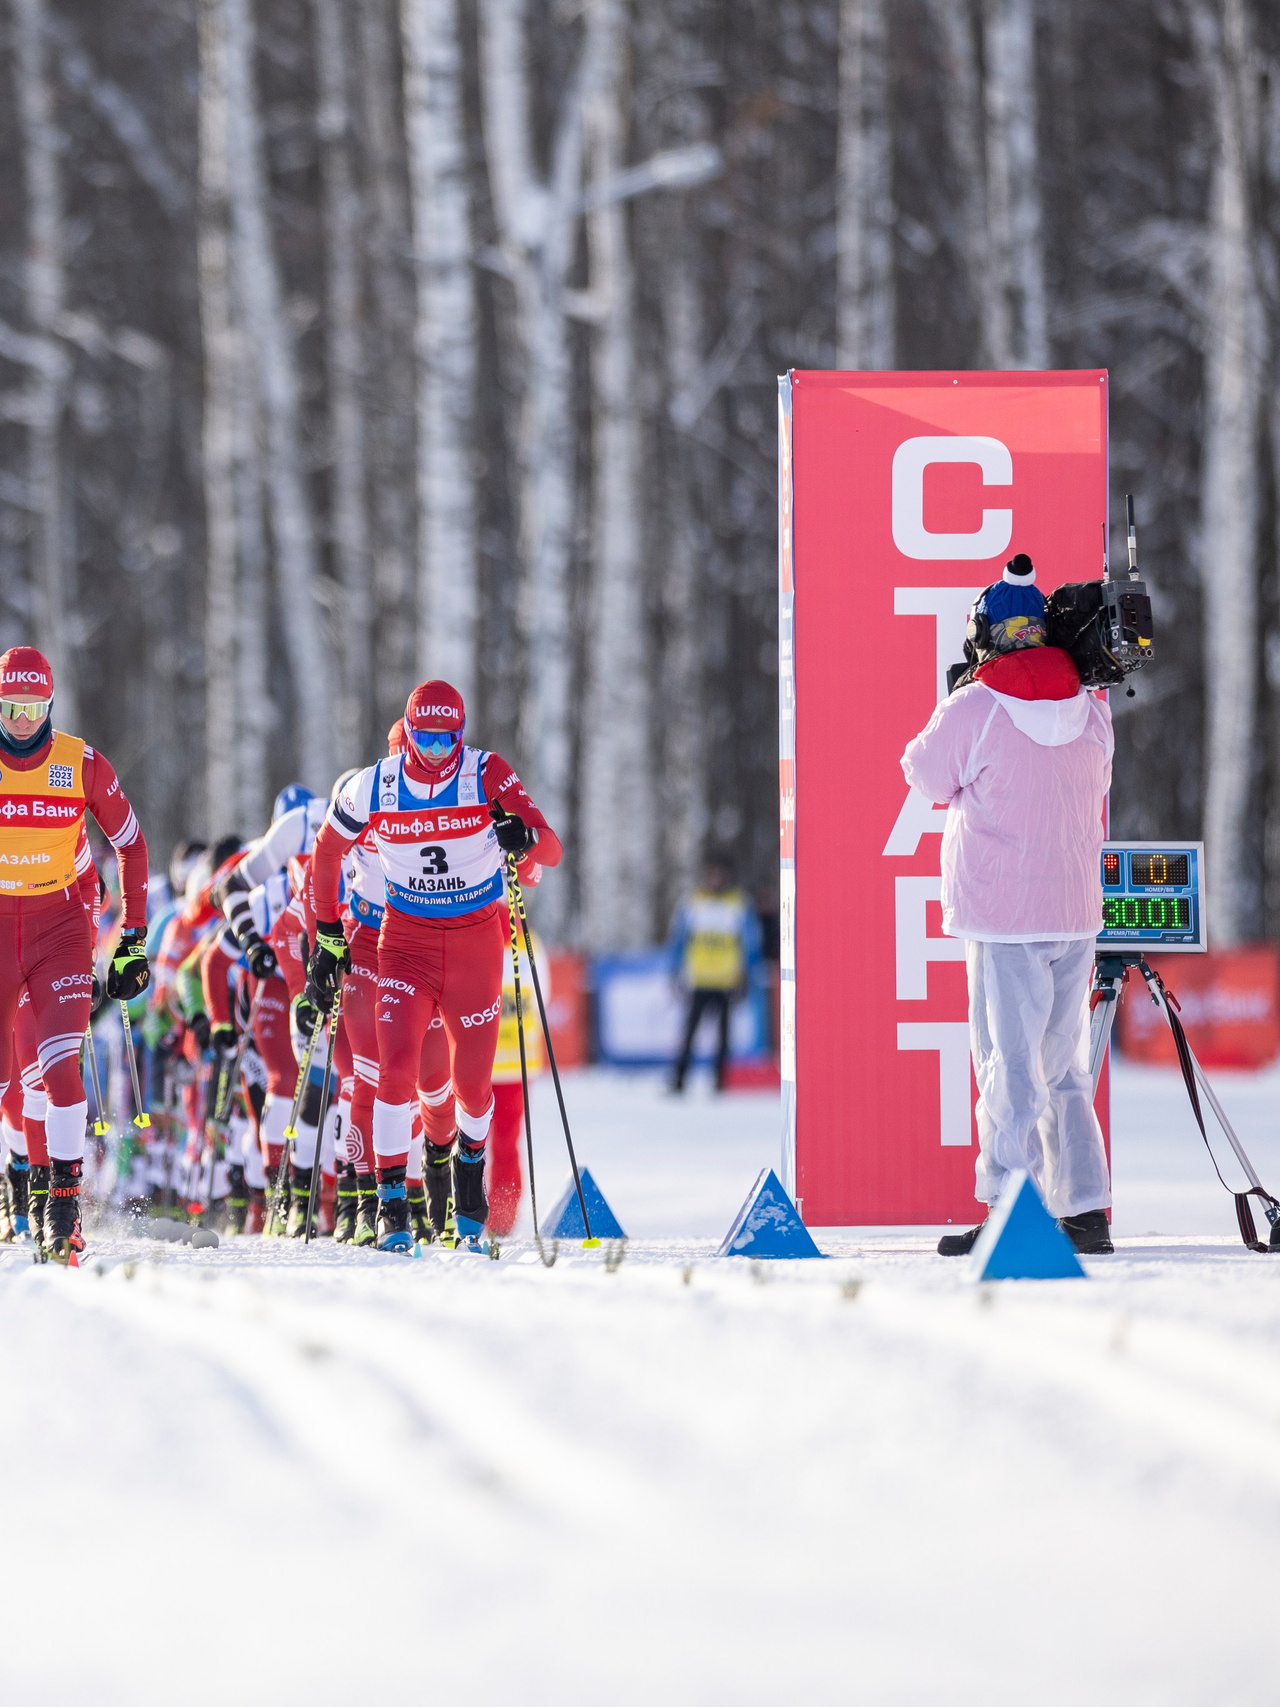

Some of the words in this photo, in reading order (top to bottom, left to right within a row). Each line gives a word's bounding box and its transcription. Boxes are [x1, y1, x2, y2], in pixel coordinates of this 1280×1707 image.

[0, 671, 49, 686] LUKOIL
[415, 705, 460, 720] LUKOIL
[49, 764, 73, 774] СЕЗОН
[49, 771, 72, 780] 2023
[49, 779, 73, 789] 2024
[32, 801, 78, 818] Банк
[378, 818, 435, 840] Альфа
[437, 815, 483, 831] Банк
[419, 845, 449, 875] 3
[1150, 854, 1167, 884] 0
[408, 876, 466, 892] КАЗАНЬ
[399, 891, 453, 905] РЕСПУБЛИКА
[51, 973, 93, 992] BOSCO
[377, 977, 417, 996] LUKOIL
[460, 995, 502, 1029] BOSCO
